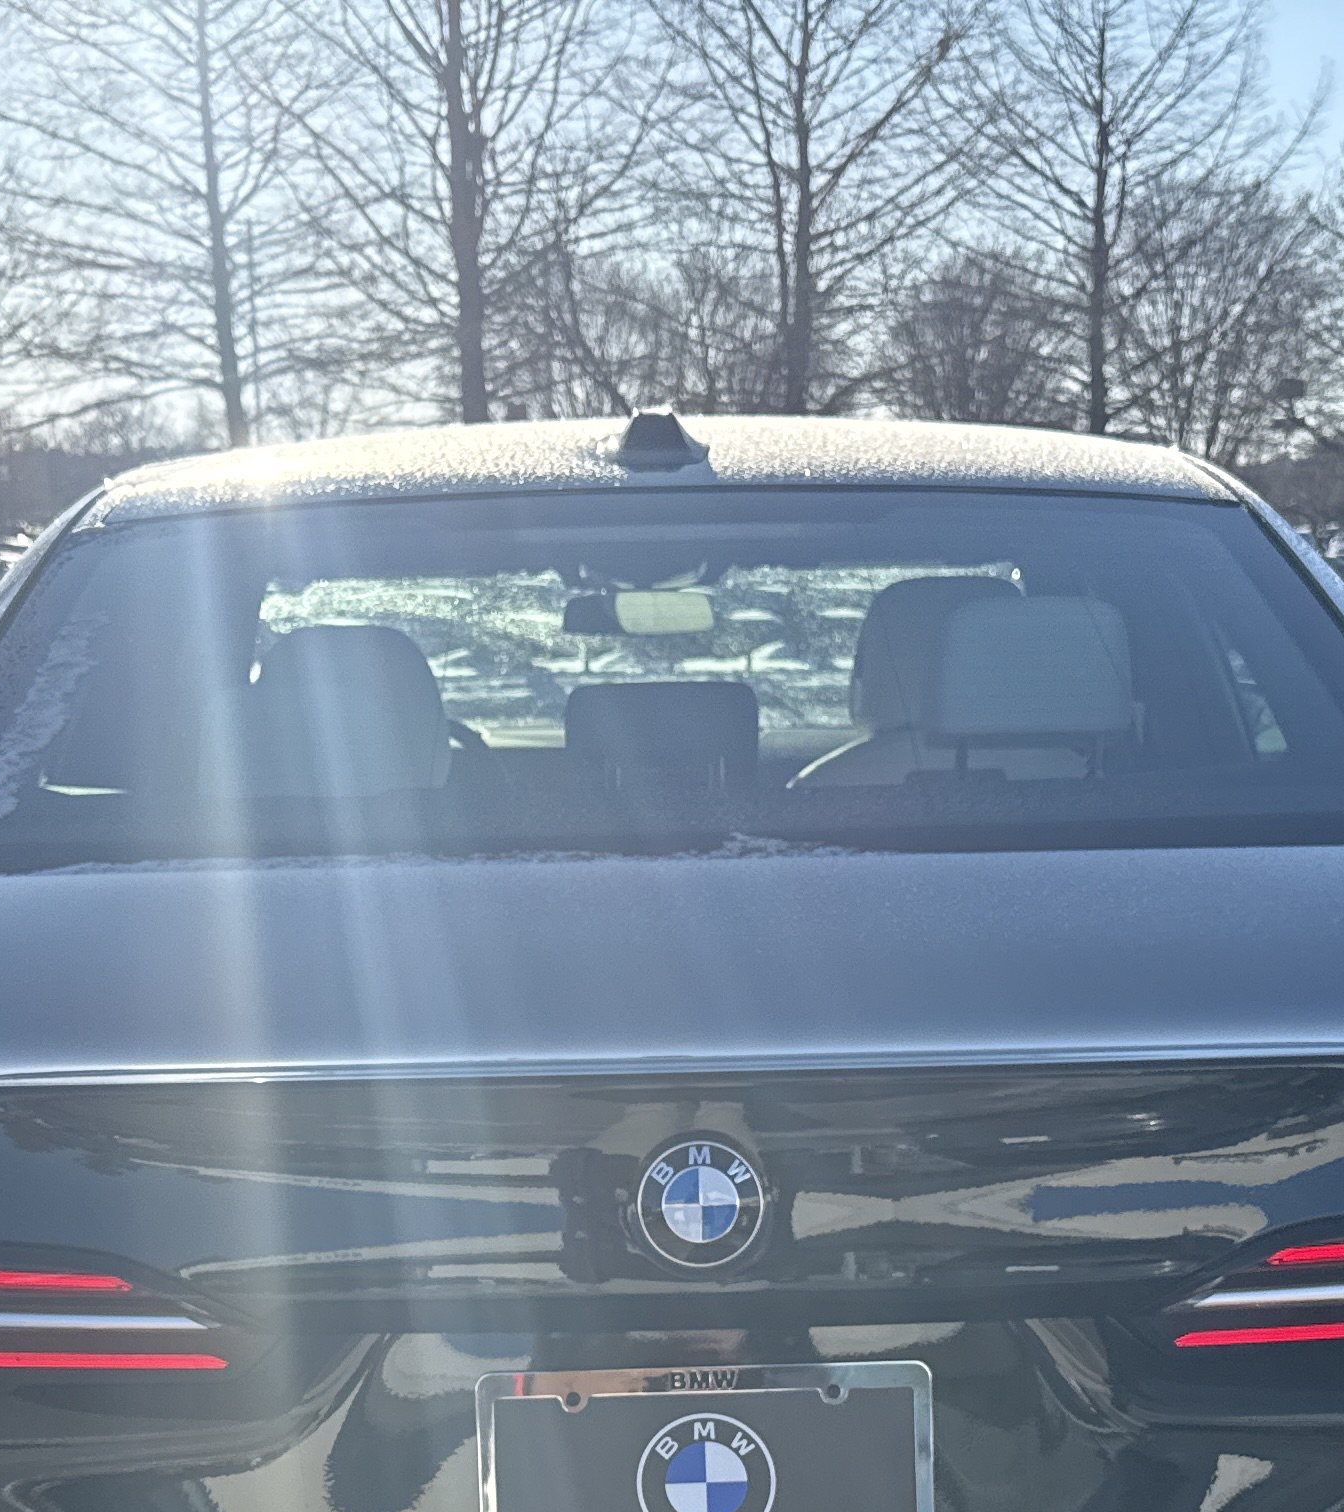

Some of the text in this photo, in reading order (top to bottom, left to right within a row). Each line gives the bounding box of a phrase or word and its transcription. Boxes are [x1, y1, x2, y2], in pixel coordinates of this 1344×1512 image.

[650, 1146, 751, 1186] BMW
[670, 1369, 739, 1391] BMW
[654, 1421, 756, 1461] BMW
